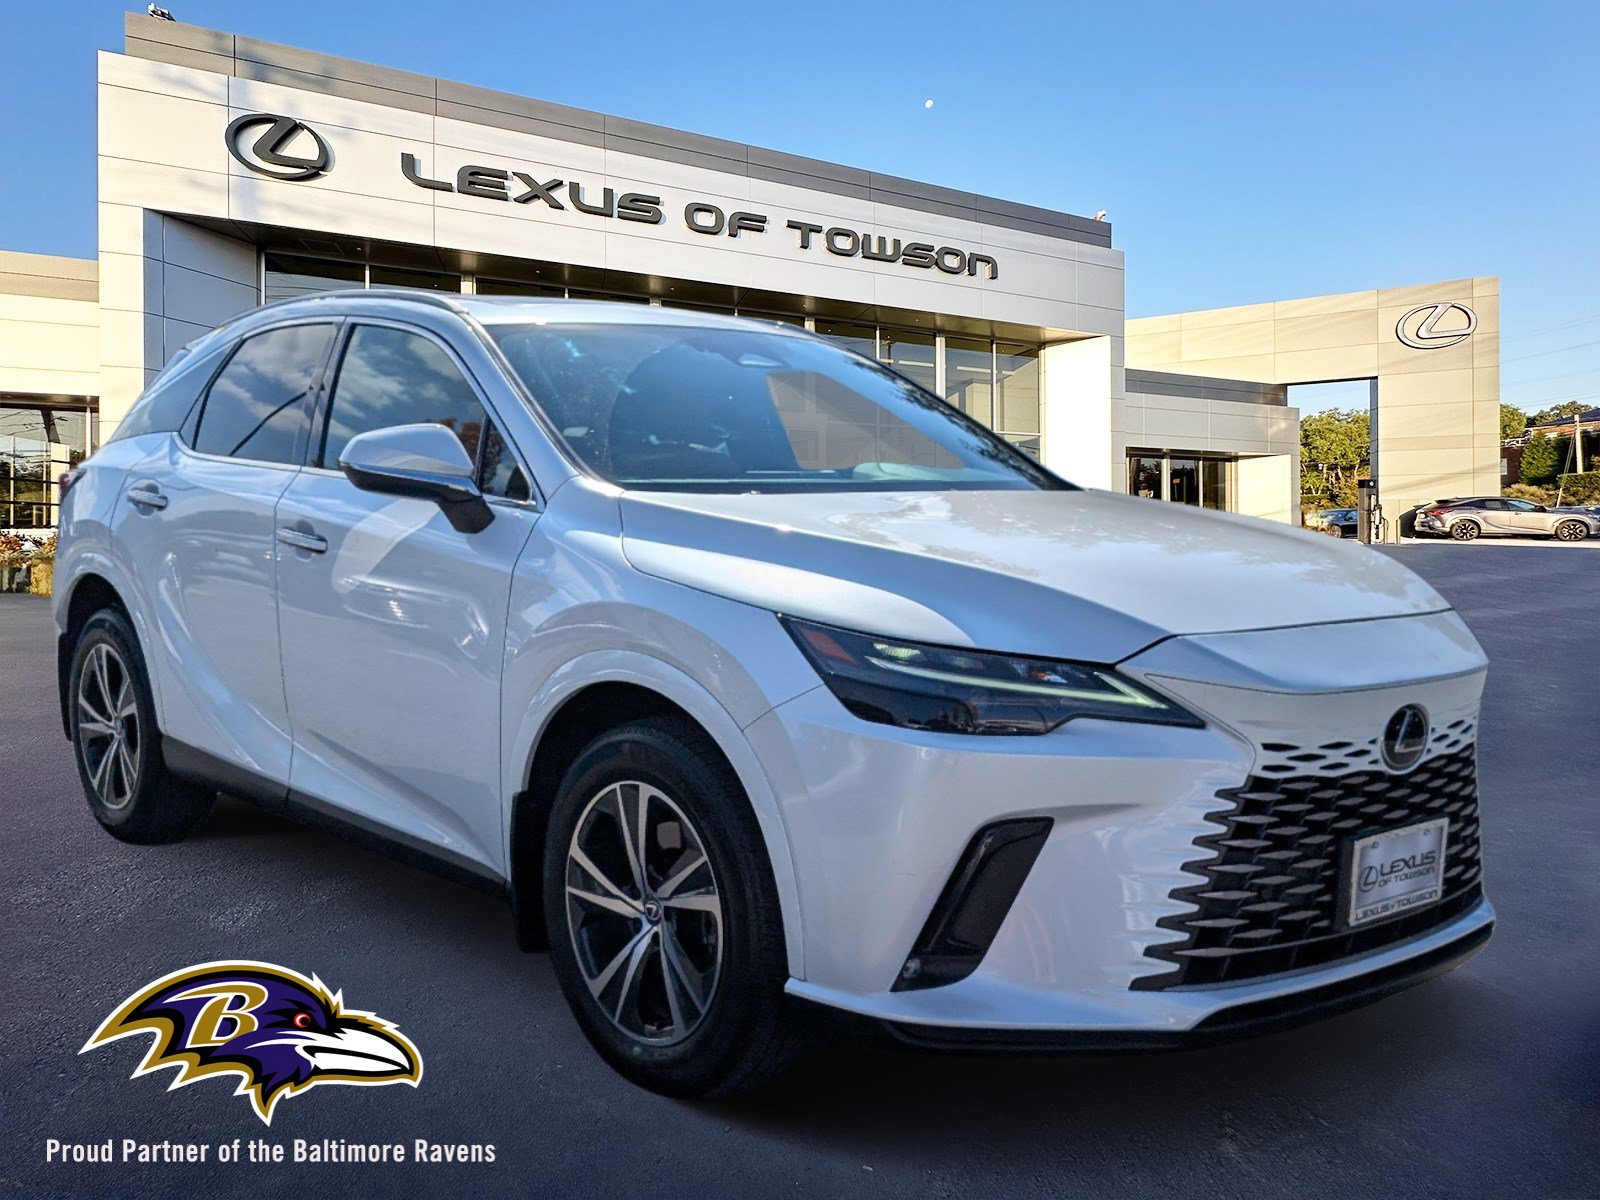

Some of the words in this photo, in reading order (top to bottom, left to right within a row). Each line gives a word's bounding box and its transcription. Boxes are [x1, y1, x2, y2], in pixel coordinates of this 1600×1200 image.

[401, 152, 665, 224] LEXUS
[684, 202, 767, 238] OF
[786, 219, 999, 280] TOWSON
[1380, 851, 1436, 876] LEXUS
